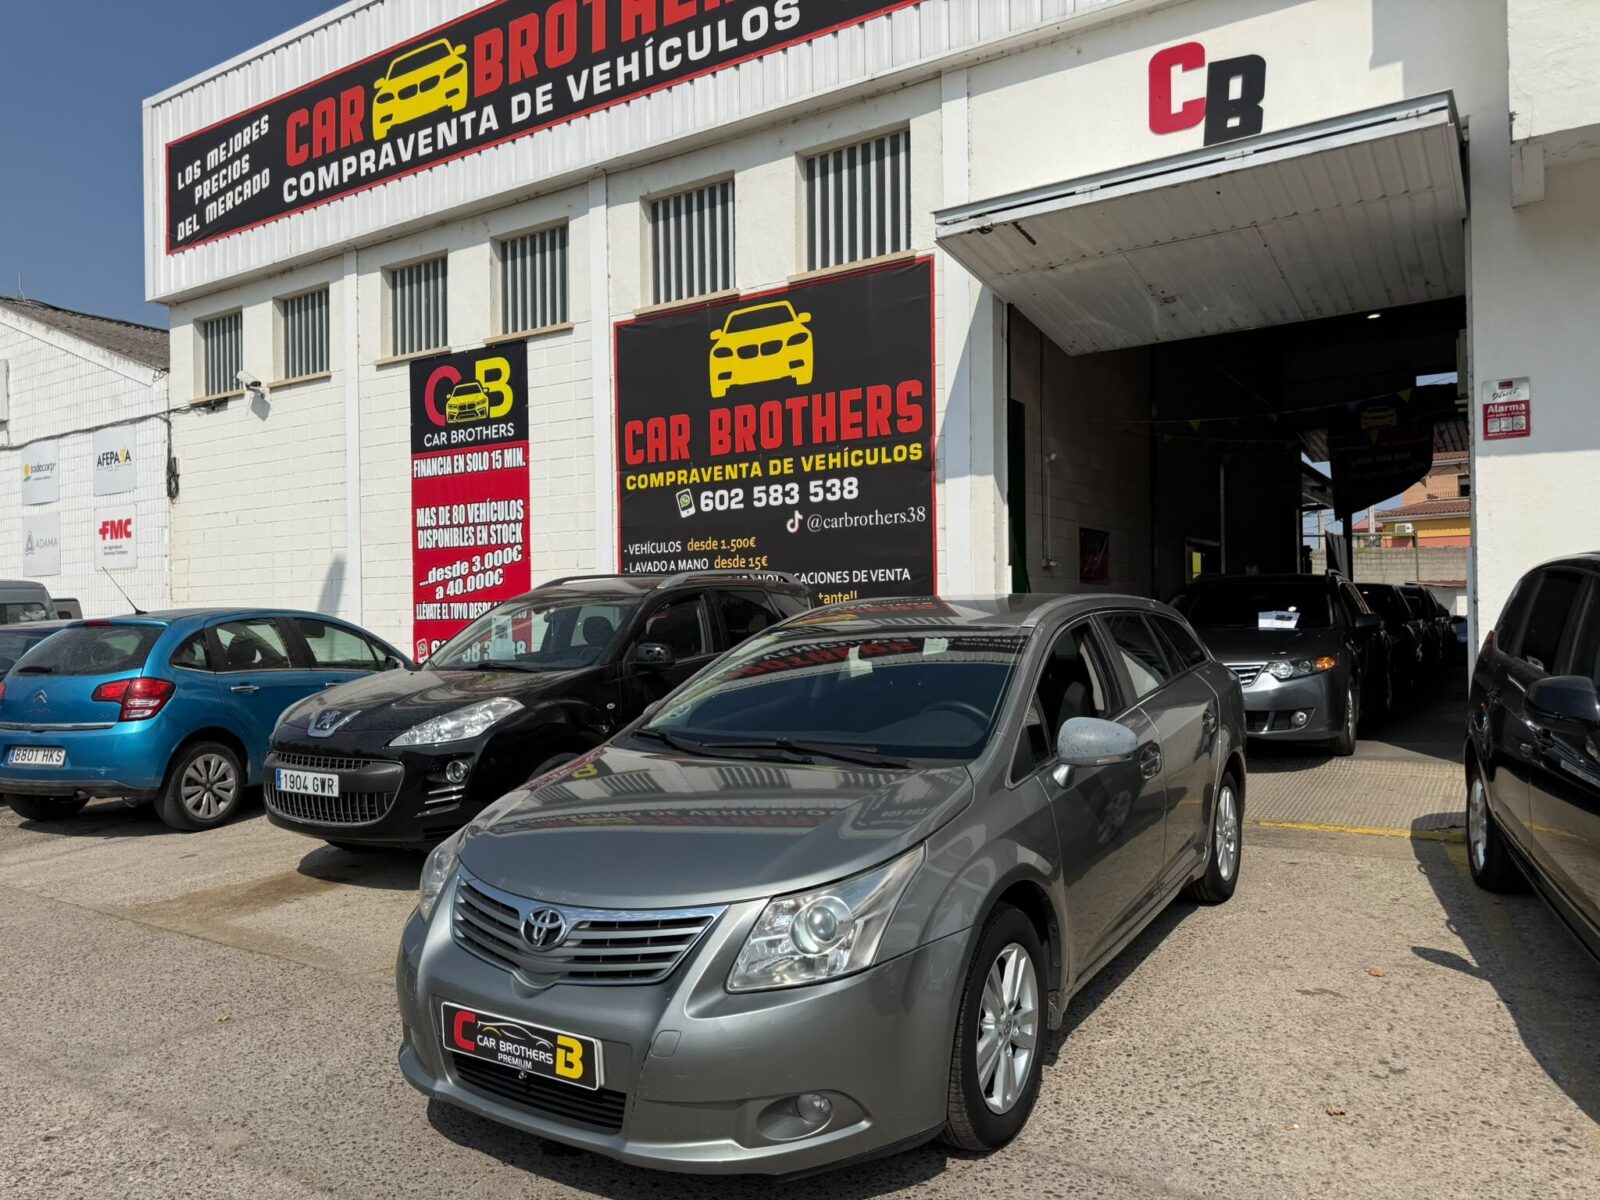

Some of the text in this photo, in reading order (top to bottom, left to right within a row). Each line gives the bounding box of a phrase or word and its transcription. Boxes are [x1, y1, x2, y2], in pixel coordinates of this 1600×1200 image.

[473, 0, 735, 98] BROTH
[283, 0, 801, 203] COMPRAVENTA DE VEHÍCULOS
[286, 85, 365, 167] CAR
[177, 114, 269, 191] LOS MEJORES
[194, 153, 250, 206] PRECIOS
[177, 167, 270, 242] DEL MERCADO
[624, 379, 924, 465] CAR BROTHERS
[1487, 403, 1526, 413] Alarma
[423, 422, 515, 447] CAR BROTHERS
[413, 447, 526, 479] FINANCIA EN SOLO 15 MIN.
[625, 442, 924, 490] COMPRAVENTA DE VEHÍCULOS
[699, 476, 860, 513] 602 583 538
[416, 497, 525, 528] MAS DE 80 VEHÍCULOS
[806, 505, 928, 533] @carbrothers38
[417, 522, 524, 550] DISPONIBLES EN STOCK
[687, 536, 720, 552] desde
[720, 536, 758, 553] 1.500€
[471, 544, 523, 573] 3.000€
[668, 559, 677, 572] A
[677, 557, 710, 572] MANO
[713, 554, 747, 569] desde
[748, 555, 770, 571] 15€
[435, 567, 505, 600] a 40.000€
[852, 570, 869, 583] DE
[869, 567, 912, 583] VENTA
[415, 600, 442, 620] LLÉVATE
[441, 602, 450, 619] EL
[449, 602, 468, 619] TUYO
[14, 747, 64, 764] 8801 HKS
[284, 773, 335, 795] 1904 GWR
[476, 1034, 554, 1065] CAR BROTHERS
[497, 1052, 533, 1071] PREMIUM
